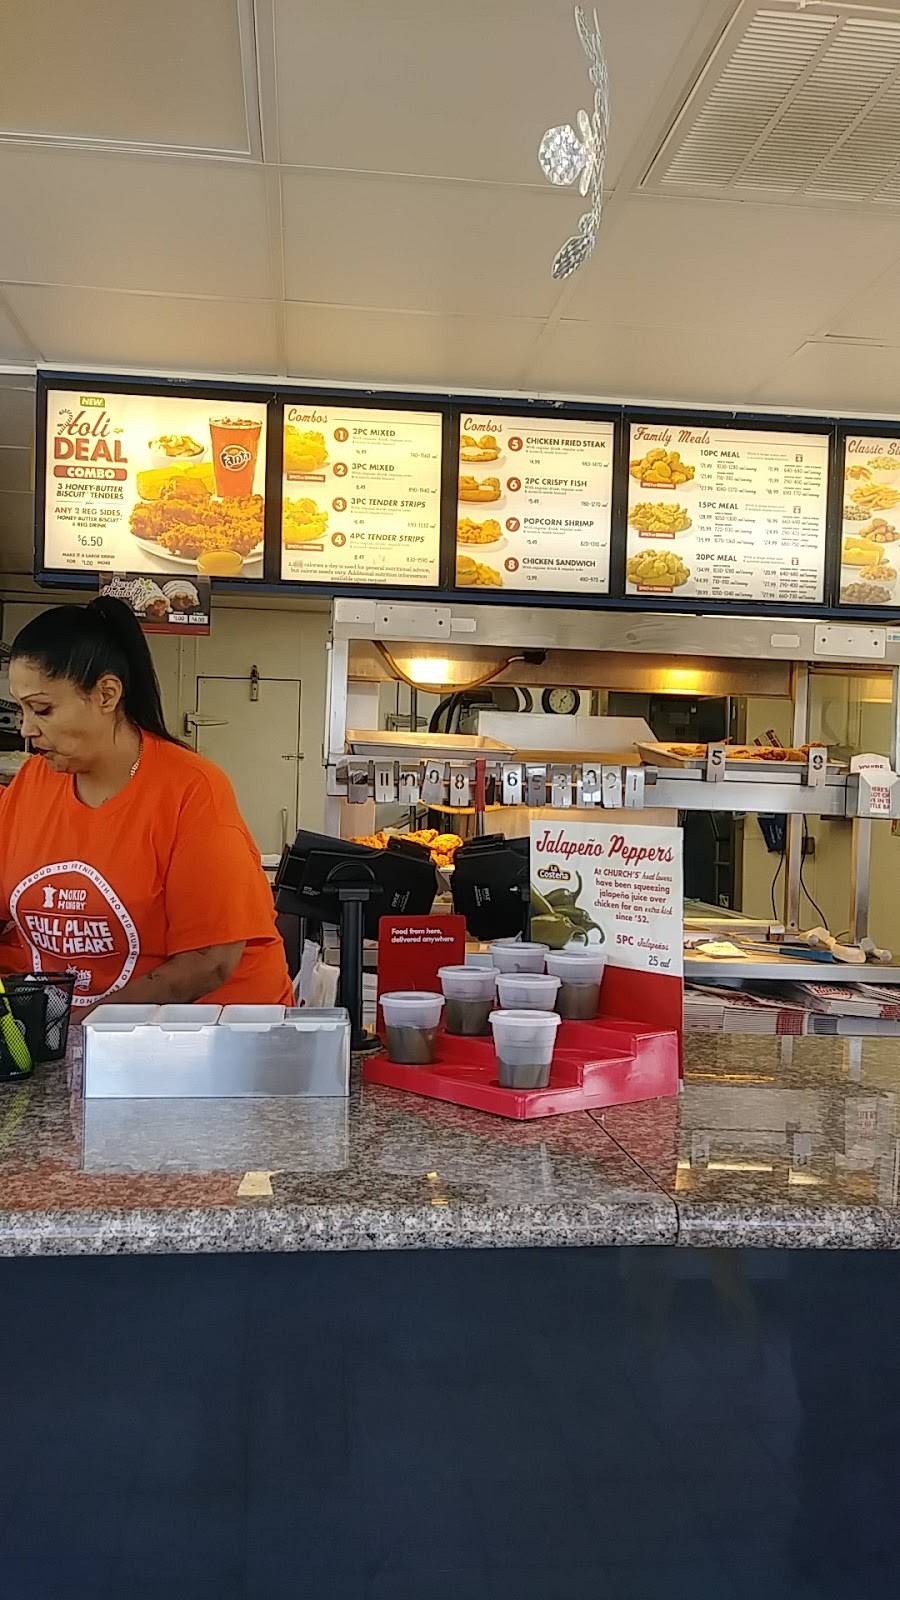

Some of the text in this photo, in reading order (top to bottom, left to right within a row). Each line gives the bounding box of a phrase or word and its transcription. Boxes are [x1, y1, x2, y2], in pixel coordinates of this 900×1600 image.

[81, 397, 104, 406] NEW
[288, 408, 328, 423] Combos
[464, 418, 503, 432] Combos
[352, 428, 368, 436] 2PC
[369, 429, 396, 437] MIXED
[634, 427, 710, 446] Family Meals
[526, 437, 560, 446] CHICKEN
[561, 438, 582, 447] FRIED
[583, 440, 606, 449] STEAK
[848, 440, 883, 455] Classic
[54, 436, 128, 463] DEAL
[700, 449, 718, 457] 10PC
[720, 451, 740, 459] MEAL
[66, 466, 116, 479] COMBO
[352, 462, 367, 471] 3PC
[369, 463, 395, 471] MIXED
[525, 477, 539, 485] 2PC
[541, 478, 568, 486] CRISPY
[570, 479, 588, 488] FISH
[91, 492, 124, 500] TENDERS
[351, 497, 366, 506] 3PC
[368, 498, 398, 507] TENDER
[400, 499, 426, 508] STRIPS
[698, 501, 717, 509] 15PC
[718, 502, 739, 510] MEAL
[54, 506, 72, 514] ANY
[82, 507, 97, 515] REG
[523, 518, 562, 526] POPCORN
[564, 519, 594, 527] SHRIMP
[78, 534, 103, 547] $6.50
[350, 532, 366, 540] 4PC
[367, 533, 397, 542] TENDER
[399, 535, 425, 543] STRIPS
[522, 557, 554, 566] CHICKEN
[556, 559, 596, 567] SANDWICH
[696, 553, 715, 561] 20PC
[102, 585, 132, 597] Potato
[712, 750, 722, 765] 5
[454, 774, 465, 790] 8
[507, 771, 518, 787] 6
[536, 829, 674, 866] Jalapeño Peppers
[594, 868, 602, 876] At
[656, 872, 673, 882] lovers
[596, 878, 670, 895] have been squeezing
[22, 867, 52, 887] PROUD
[94, 874, 110, 895] WITH
[110, 896, 121, 910] NO
[121, 913, 132, 929] KID
[599, 889, 630, 900] jalapeño
[631, 892, 648, 902] juice
[57, 900, 87, 910] HUNGRY
[594, 899, 619, 909] chicken
[621, 901, 632, 910] for
[660, 906, 673, 915] kick
[616, 912, 649, 924] since '52.
[25, 915, 112, 938] FULL PLATE
[391, 927, 442, 935] Food from here,
[63, 936, 115, 954] HEART
[391, 936, 455, 945] delivered anywhere
[616, 934, 634, 946] 5PC
[649, 954, 672, 968] 25 cal
